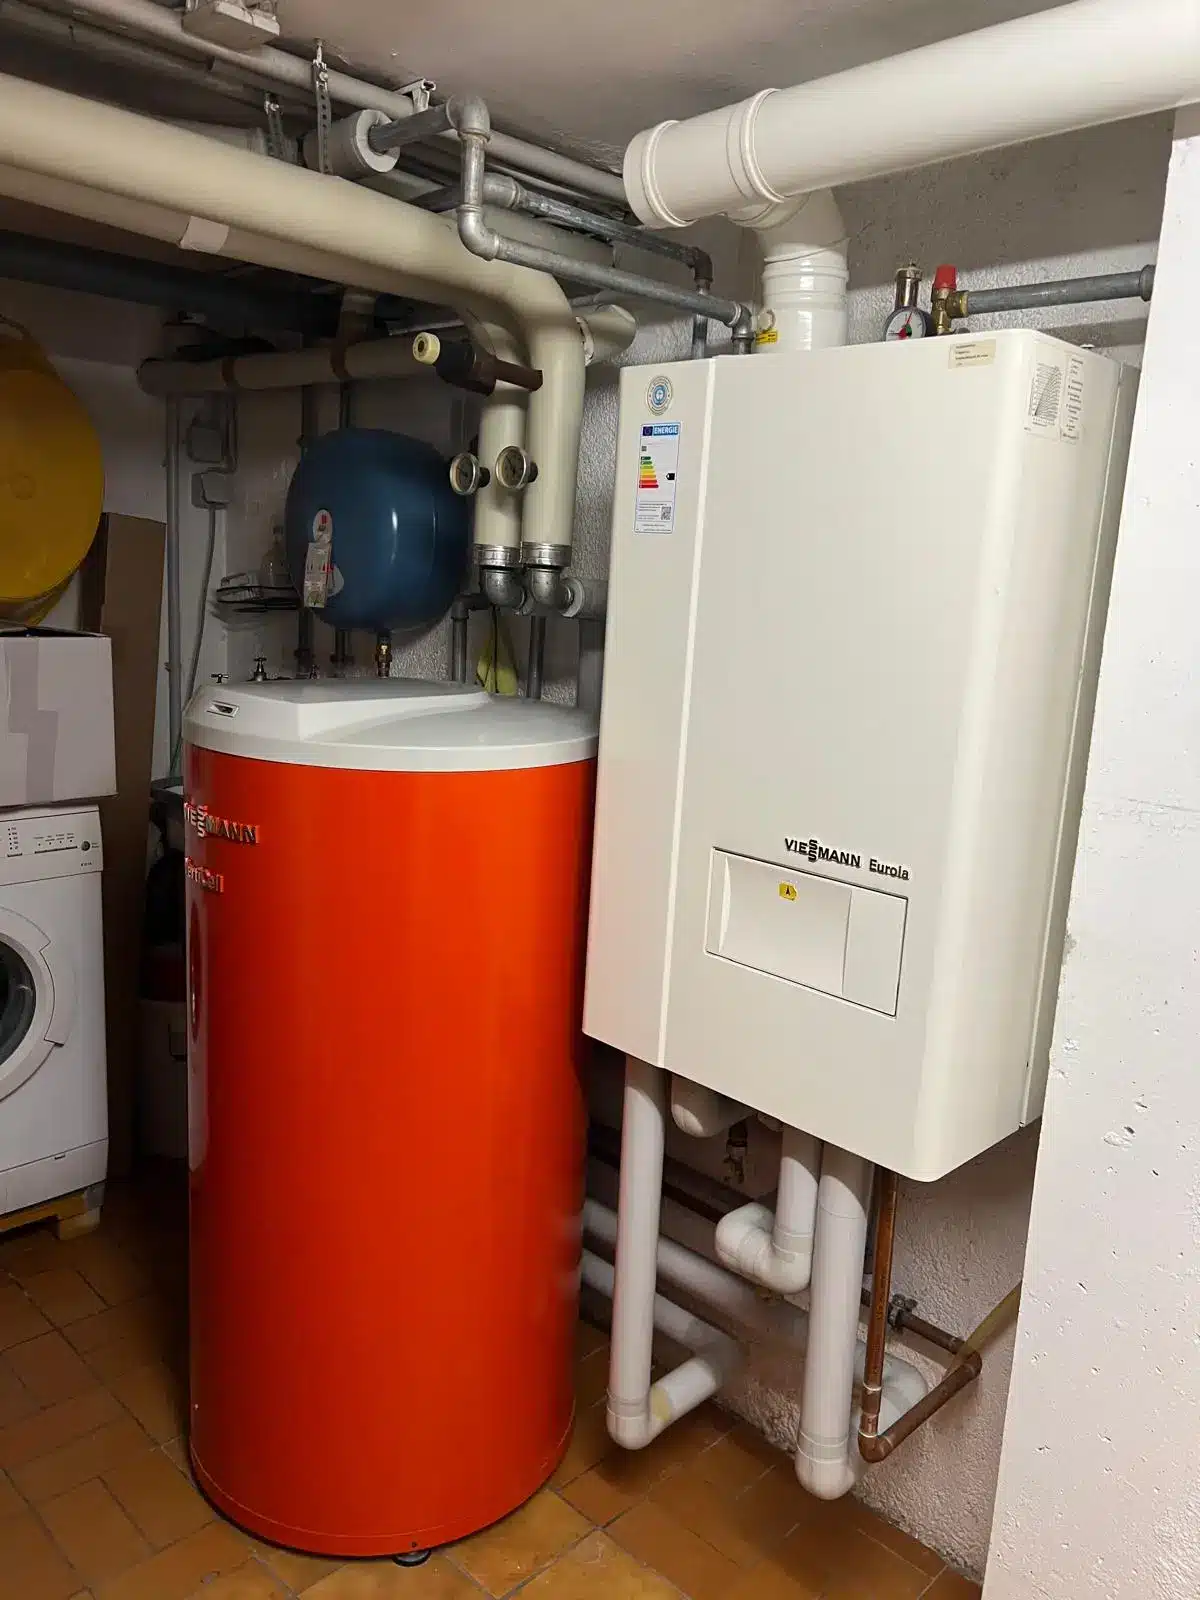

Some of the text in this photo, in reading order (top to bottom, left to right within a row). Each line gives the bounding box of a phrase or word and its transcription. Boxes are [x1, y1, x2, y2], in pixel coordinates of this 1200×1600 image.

[654, 425, 678, 434] ENERGIE
[785, 838, 909, 880] VIESSMANN Eurola
